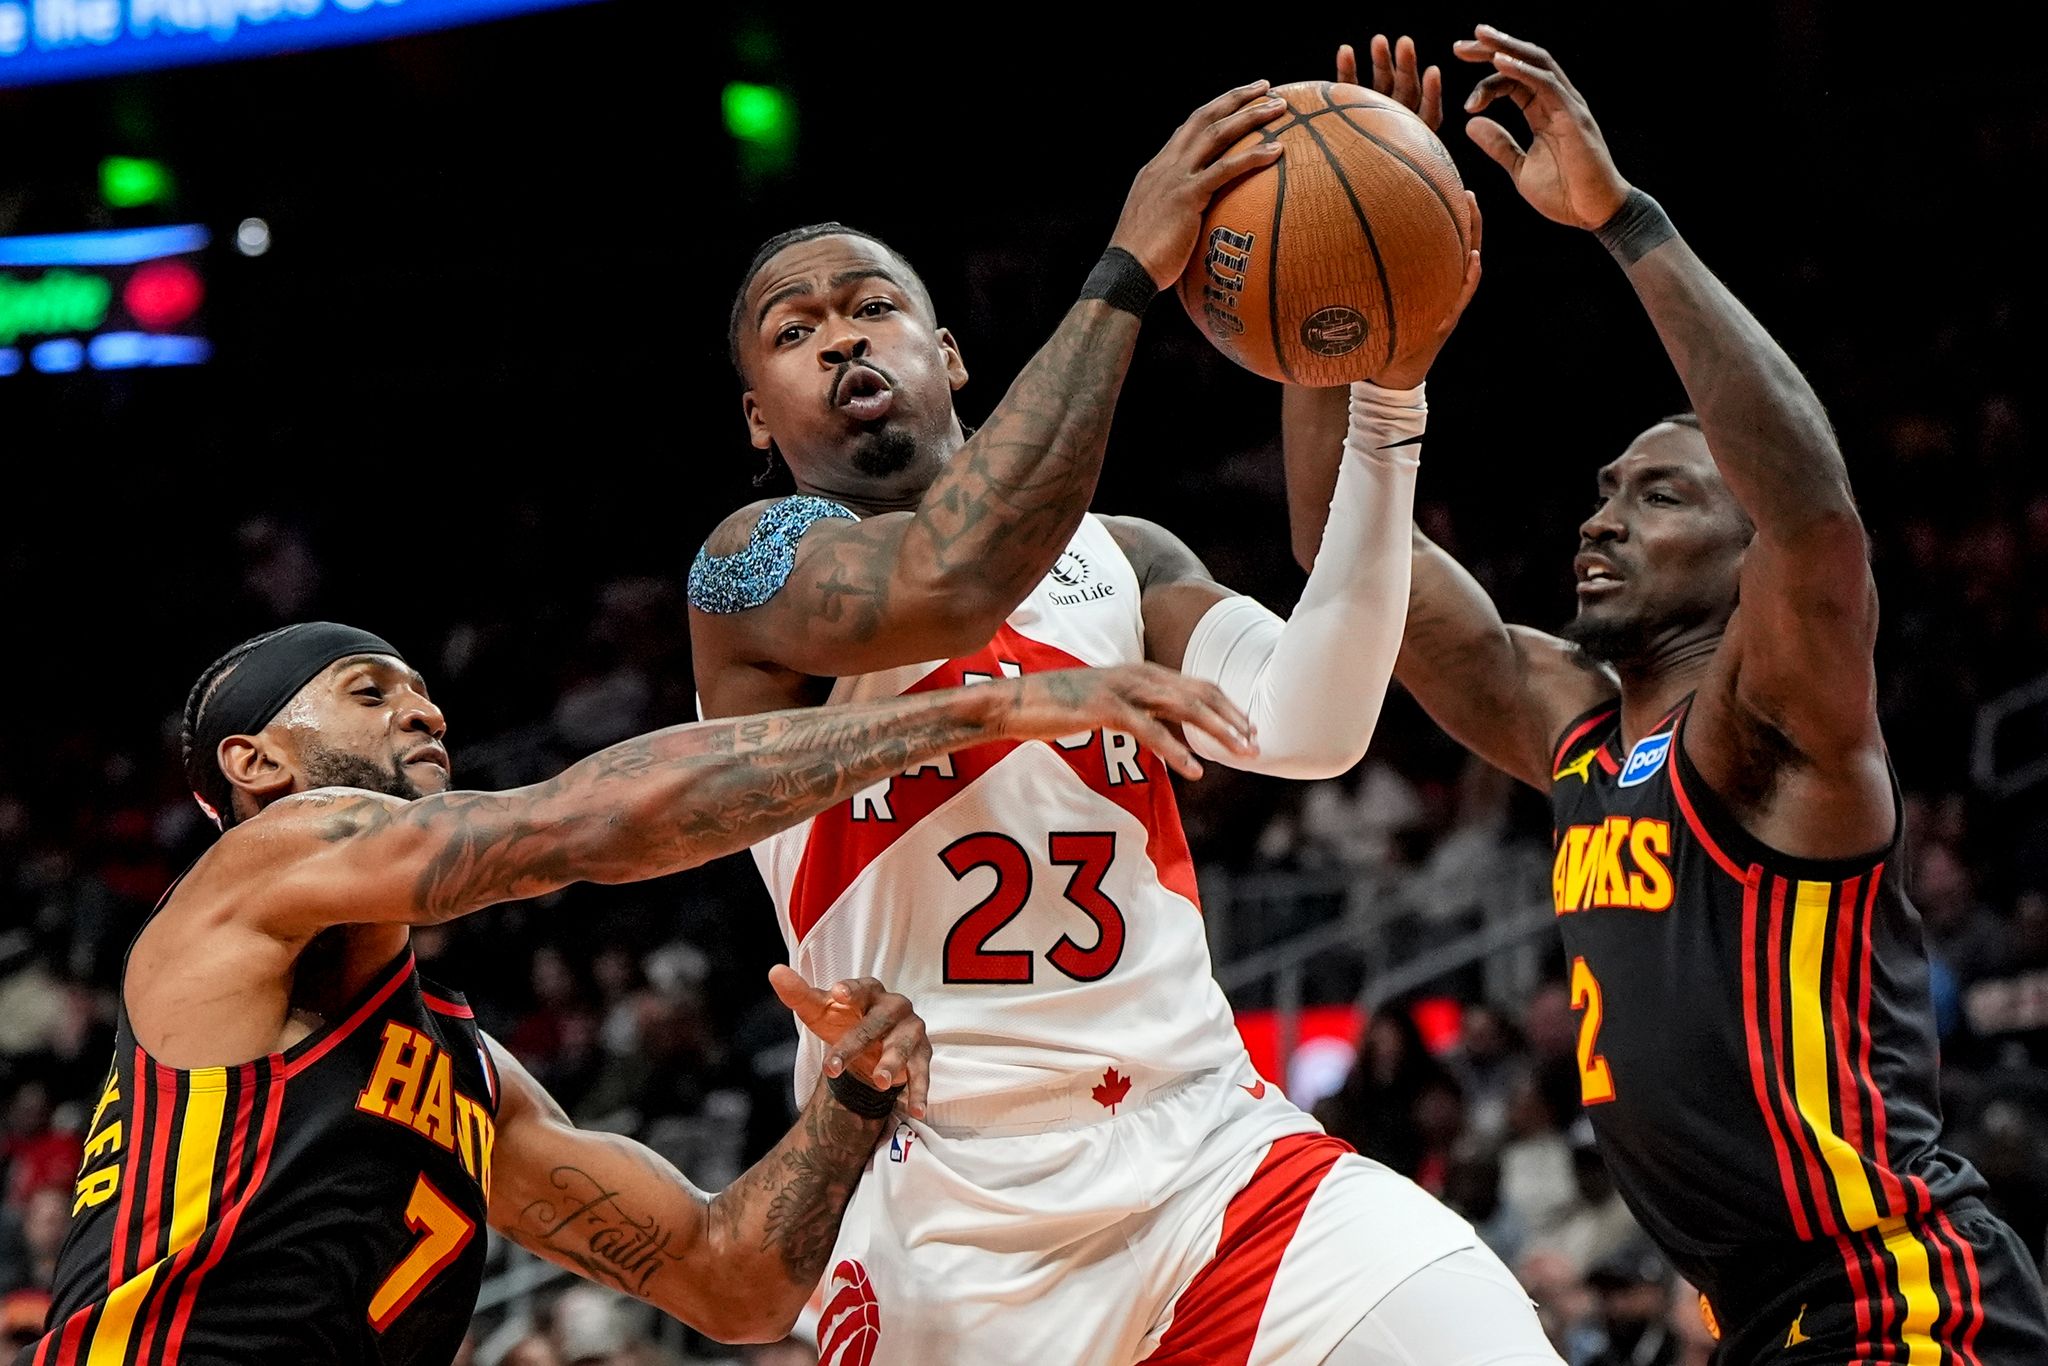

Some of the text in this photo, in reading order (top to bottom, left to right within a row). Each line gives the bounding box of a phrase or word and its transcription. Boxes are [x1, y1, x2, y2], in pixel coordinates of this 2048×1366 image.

[1048, 582, 1116, 606] Sun Life
[937, 831, 1126, 984] 23
[1570, 955, 1617, 1107] 2
[367, 1170, 476, 1334] 7
[518, 1165, 685, 1297] Faith
